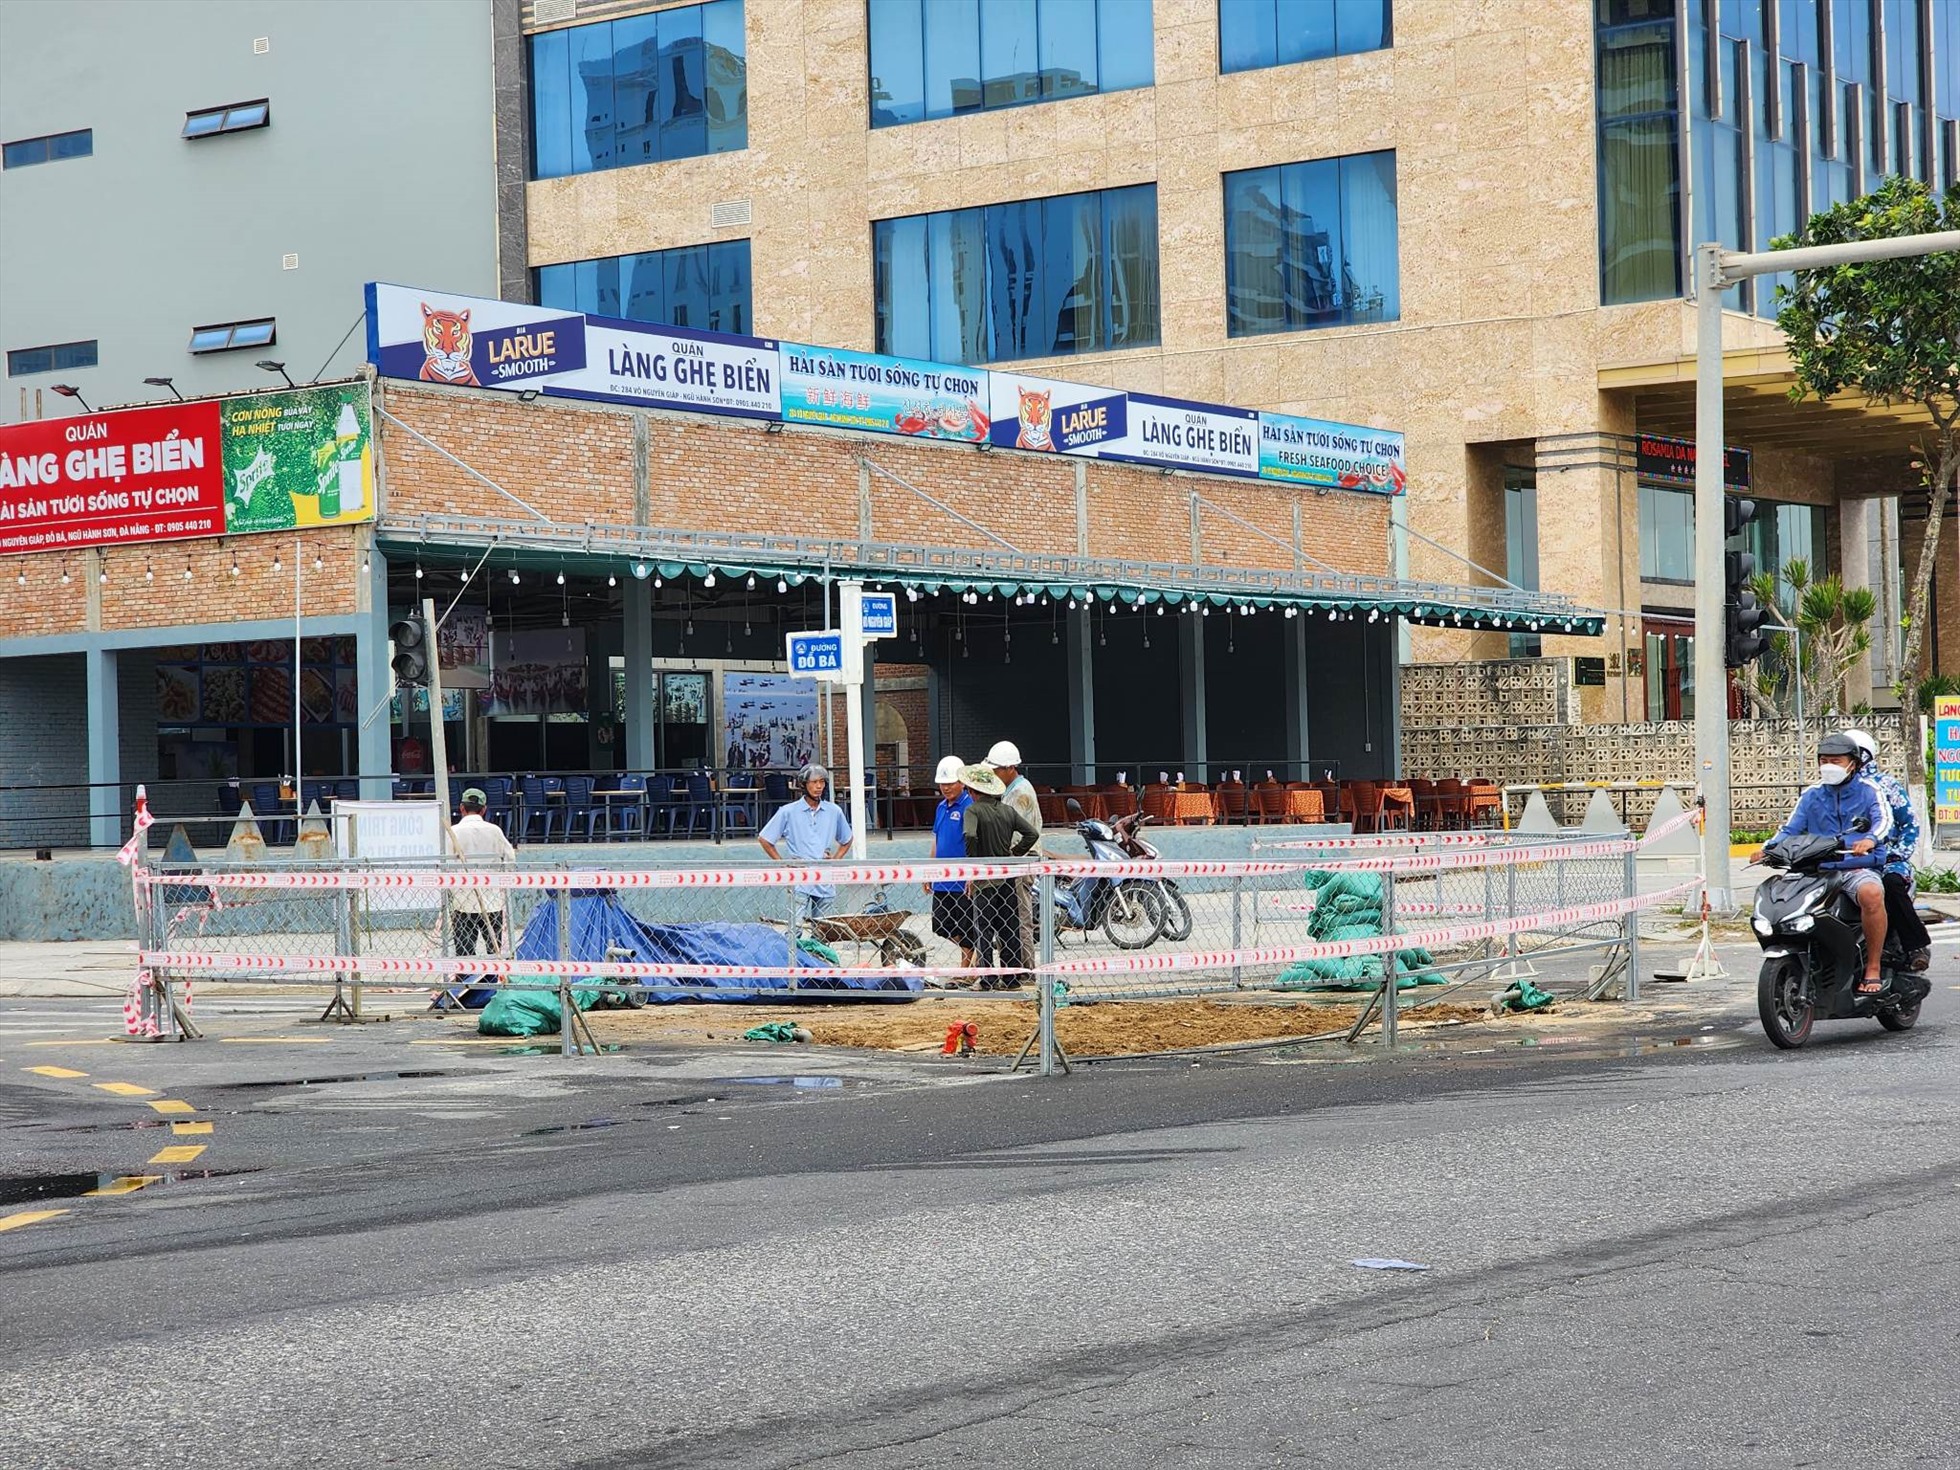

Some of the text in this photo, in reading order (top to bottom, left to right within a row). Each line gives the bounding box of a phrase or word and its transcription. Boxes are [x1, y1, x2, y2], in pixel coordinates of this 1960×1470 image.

[488, 331, 556, 363] LARUE
[672, 341, 704, 357] QUÁN
[498, 357, 549, 379] SMOOTH
[608, 343, 771, 395] LÀNG GHẸ BIỂN
[789, 350, 979, 398] HẢI SẢN TƯƠI SỐNG TỰ CHỌN
[65, 420, 109, 442] QUÁN
[1061, 406, 1107, 434] LARUE
[1185, 413, 1207, 425] QUÁN
[1068, 427, 1102, 446] SMOOTH
[1142, 416, 1252, 457] LÀNG GHẸ BIỂN
[1284, 424, 1304, 444] SẢN
[1332, 431, 1357, 451] SỐNG
[1360, 438, 1374, 459] TỰ
[0, 428, 204, 489] ÀNG GHẸ BIỂN
[1641, 440, 1675, 459] ROSAMIA
[1278, 450, 1386, 476] FRESH SEAFOOD CHOICE
[240, 459, 269, 494] Sprite
[17, 497, 48, 519] SẢN
[50, 494, 85, 516] TƯƠI
[87, 489, 129, 512] SỐNG
[132, 486, 152, 509] TỰ
[155, 485, 199, 506] CHỌN
[82, 527, 102, 540] HÀNH
[119, 525, 129, 537] ĐÀ
[167, 521, 184, 533] 0905
[185, 520, 197, 531] 440
[198, 519, 212, 530] 210
[811, 641, 838, 652] ĐƯỜNG
[797, 651, 837, 669] ĐỖ BÁ
[1938, 809, 1952, 820] ĐT:
